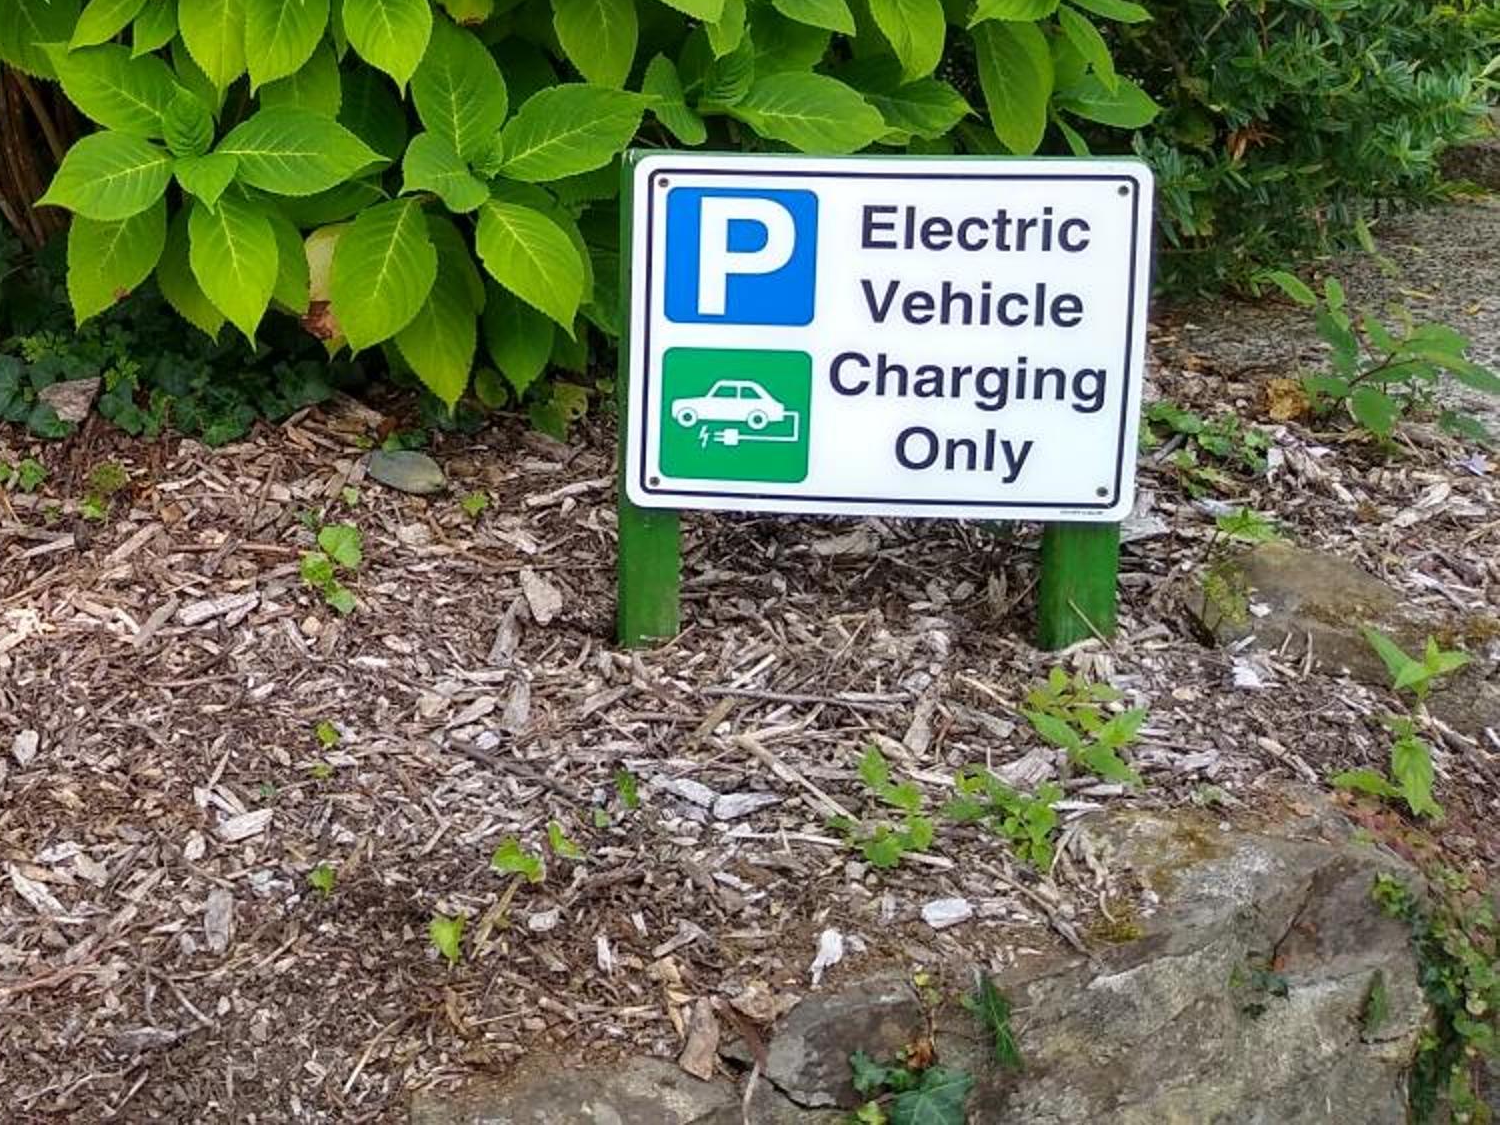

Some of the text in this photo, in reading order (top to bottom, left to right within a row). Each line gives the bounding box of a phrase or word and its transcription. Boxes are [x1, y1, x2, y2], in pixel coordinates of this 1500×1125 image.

[697, 196, 797, 315] P
[861, 204, 1091, 253] Electric
[861, 279, 1084, 327] Vehicle
[829, 351, 1107, 413] Charging
[894, 426, 1033, 484] Only
